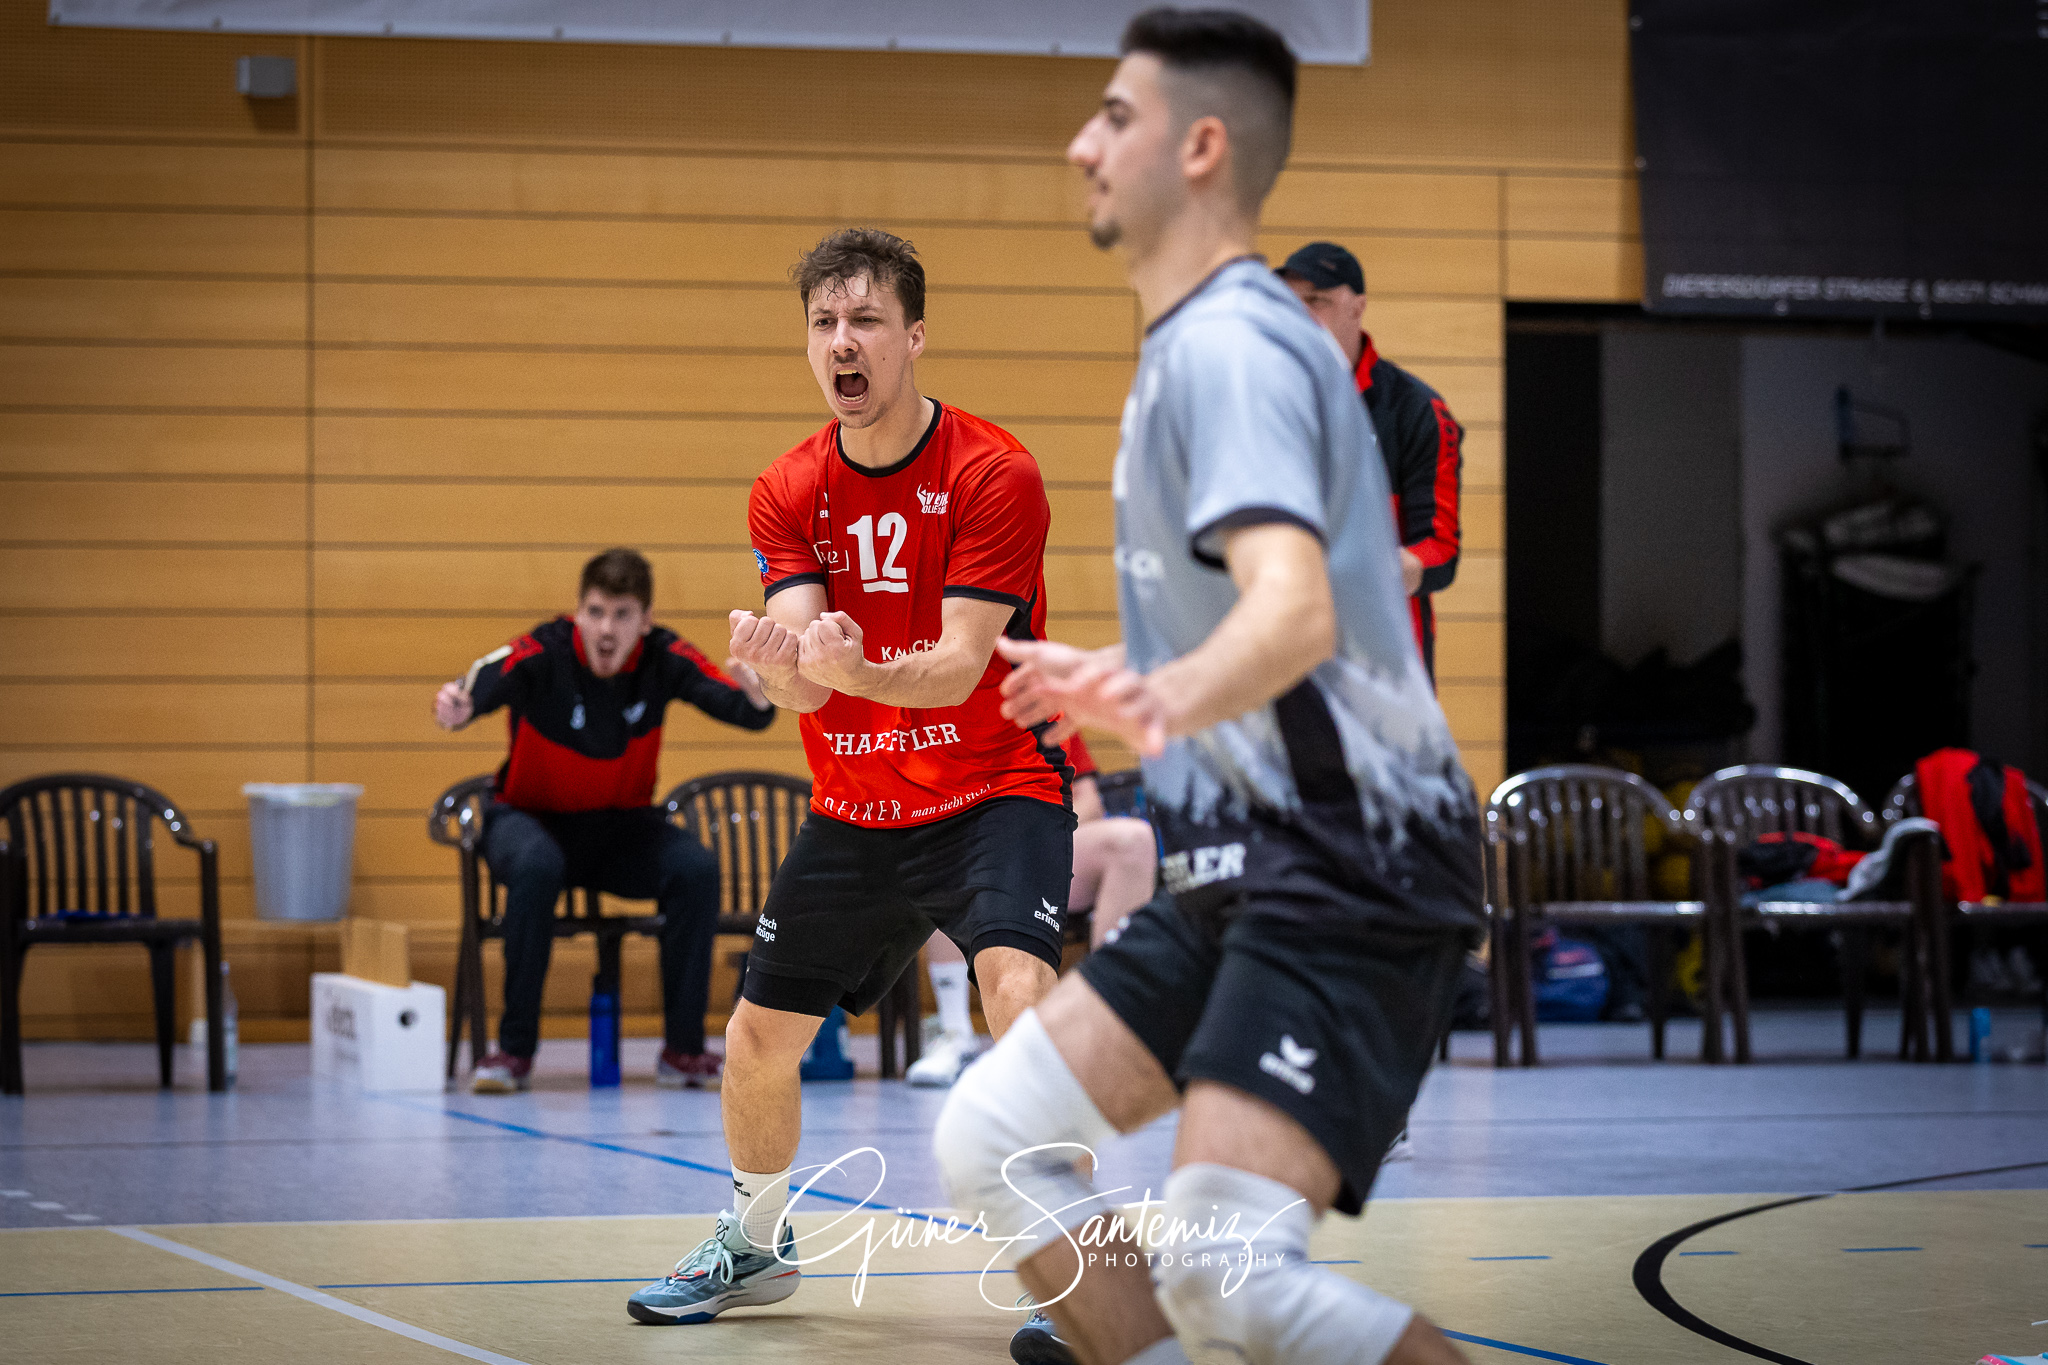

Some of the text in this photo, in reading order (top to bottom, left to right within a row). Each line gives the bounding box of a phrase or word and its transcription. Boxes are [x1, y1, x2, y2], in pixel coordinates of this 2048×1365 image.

[846, 512, 908, 580] 12
[911, 806, 937, 818] man
[1034, 910, 1060, 933] erima
